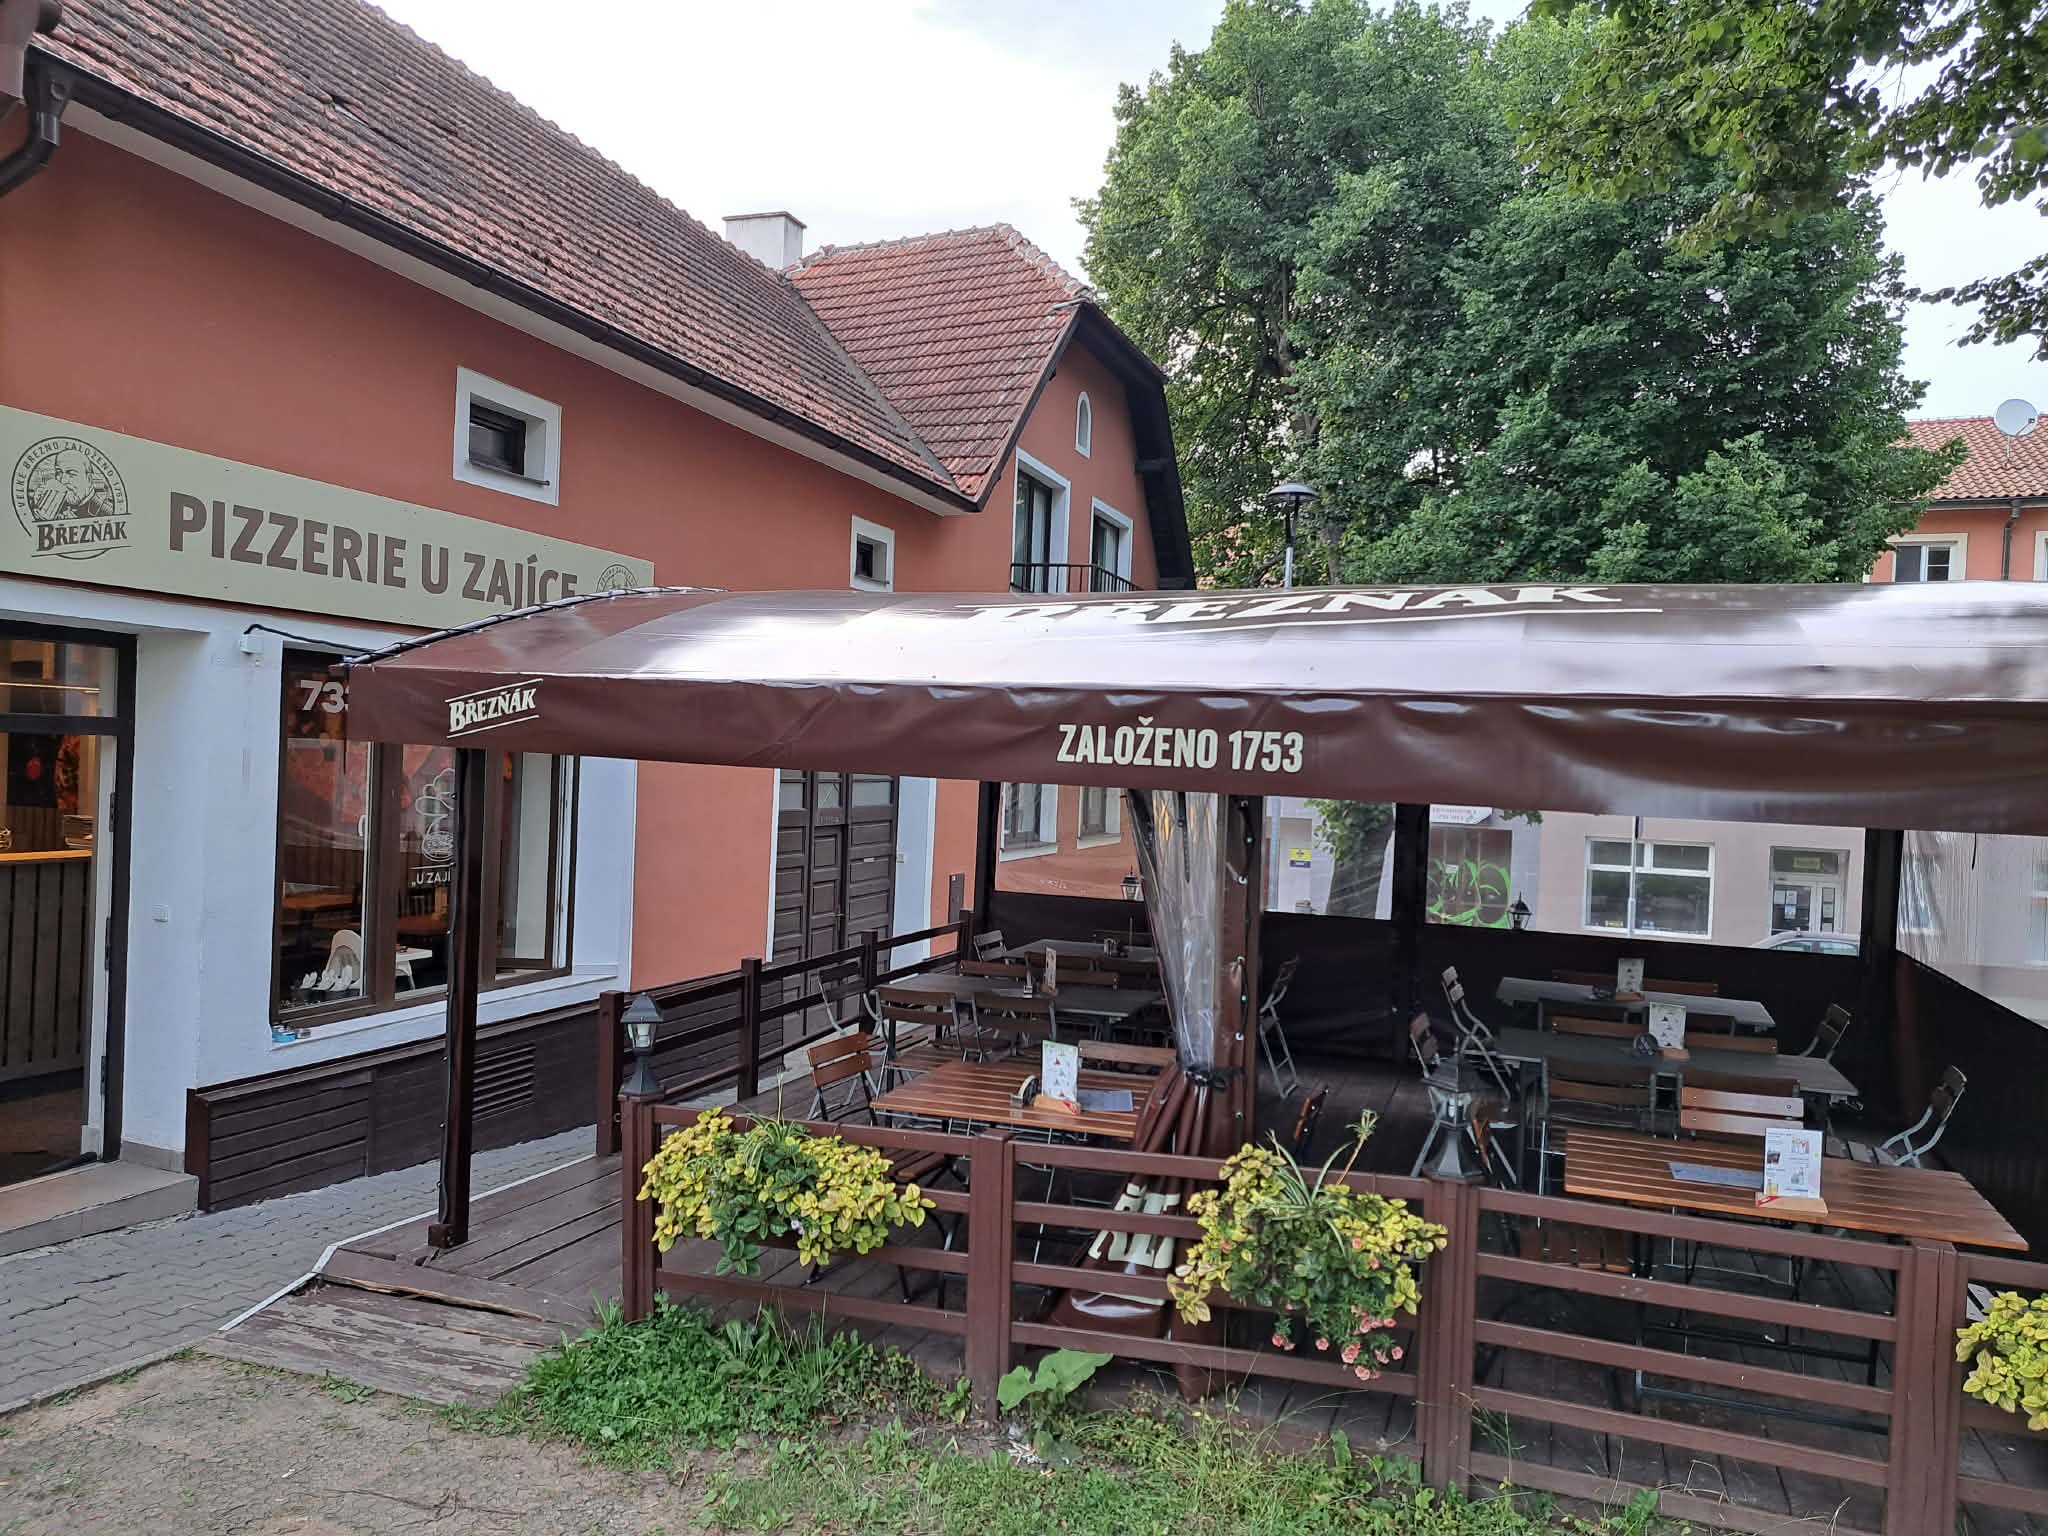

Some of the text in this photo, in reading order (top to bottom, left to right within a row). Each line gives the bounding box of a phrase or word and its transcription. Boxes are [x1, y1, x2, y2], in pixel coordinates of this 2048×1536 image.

[169, 491, 407, 589] PIZZERIE
[421, 543, 449, 595] U
[300, 679, 349, 714] 73
[1056, 715, 1304, 773] ZALOŽENO 1753
[426, 867, 452, 884] ZAJÍ
